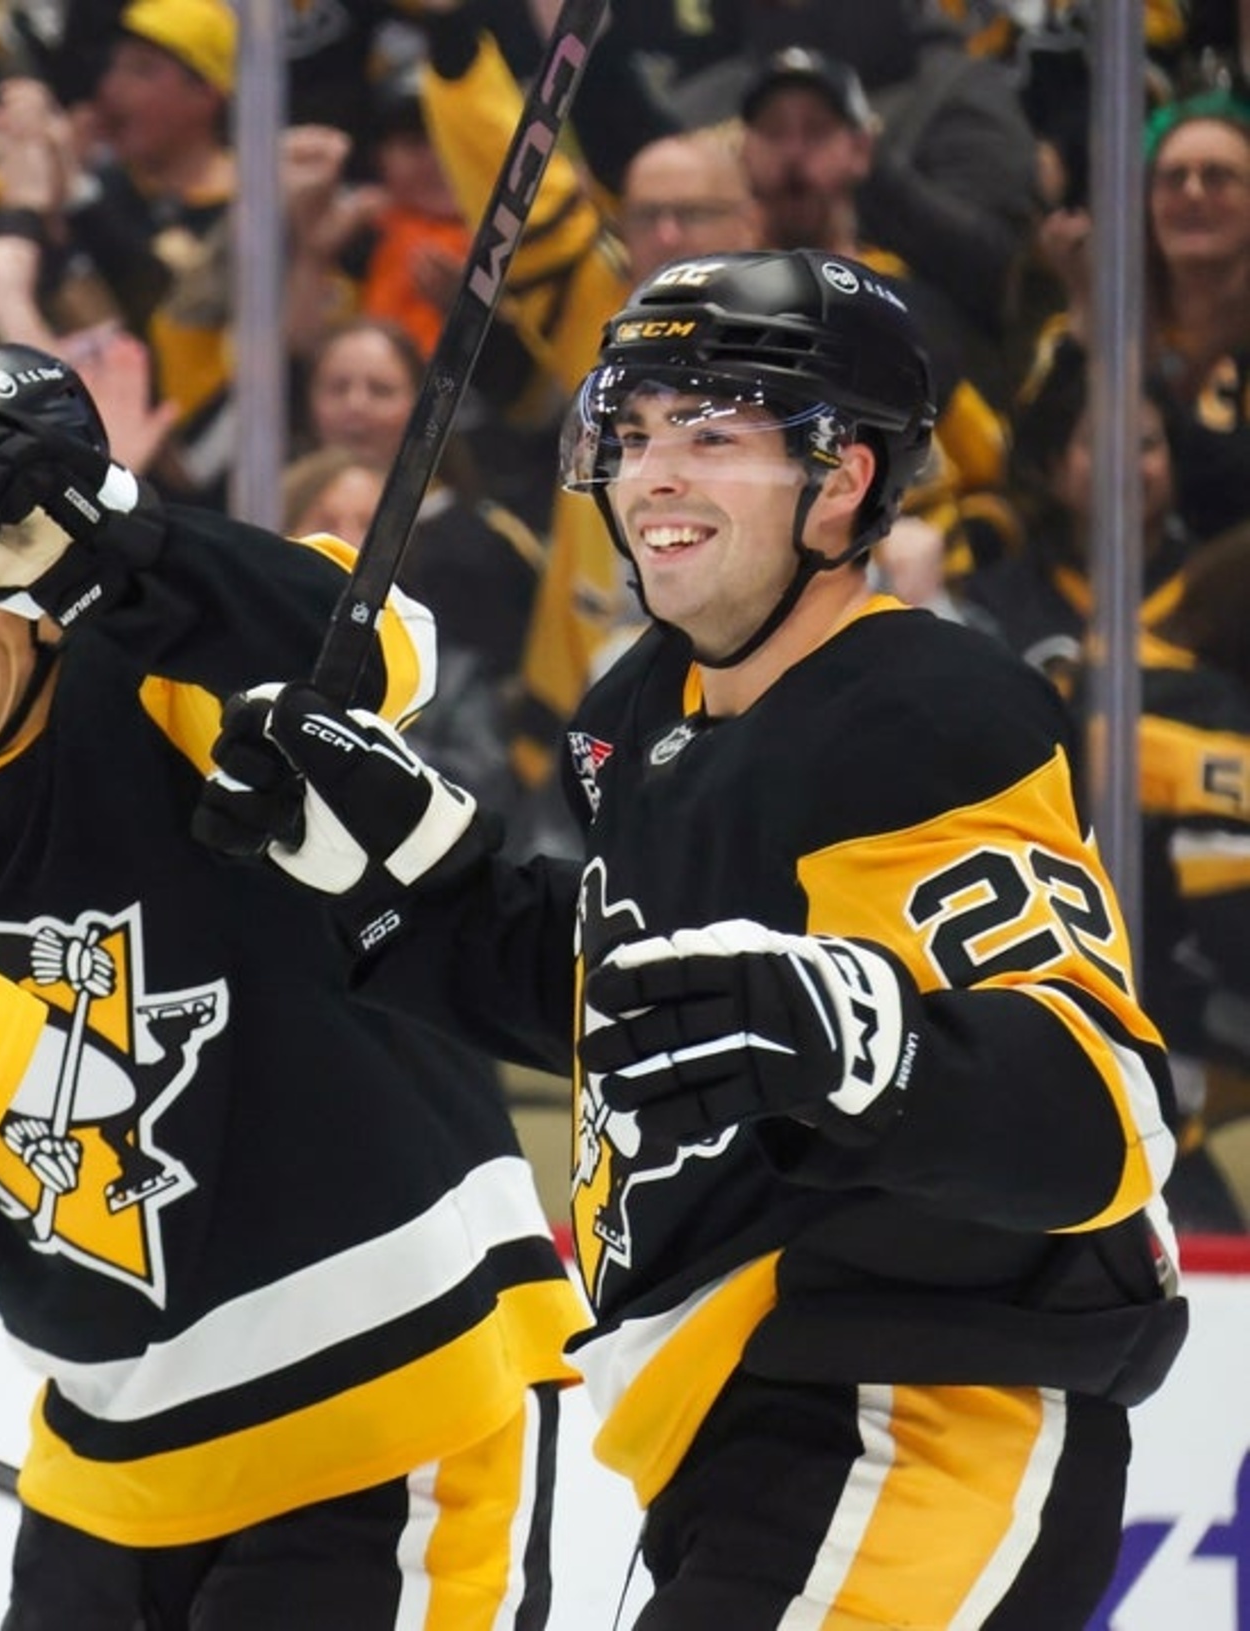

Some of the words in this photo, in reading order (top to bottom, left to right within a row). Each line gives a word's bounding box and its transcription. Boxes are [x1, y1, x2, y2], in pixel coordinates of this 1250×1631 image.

[468, 33, 587, 307] CCM
[300, 721, 355, 753] CCM
[361, 913, 401, 950] CCM
[903, 843, 1131, 998] 22
[814, 935, 880, 1085] CM
